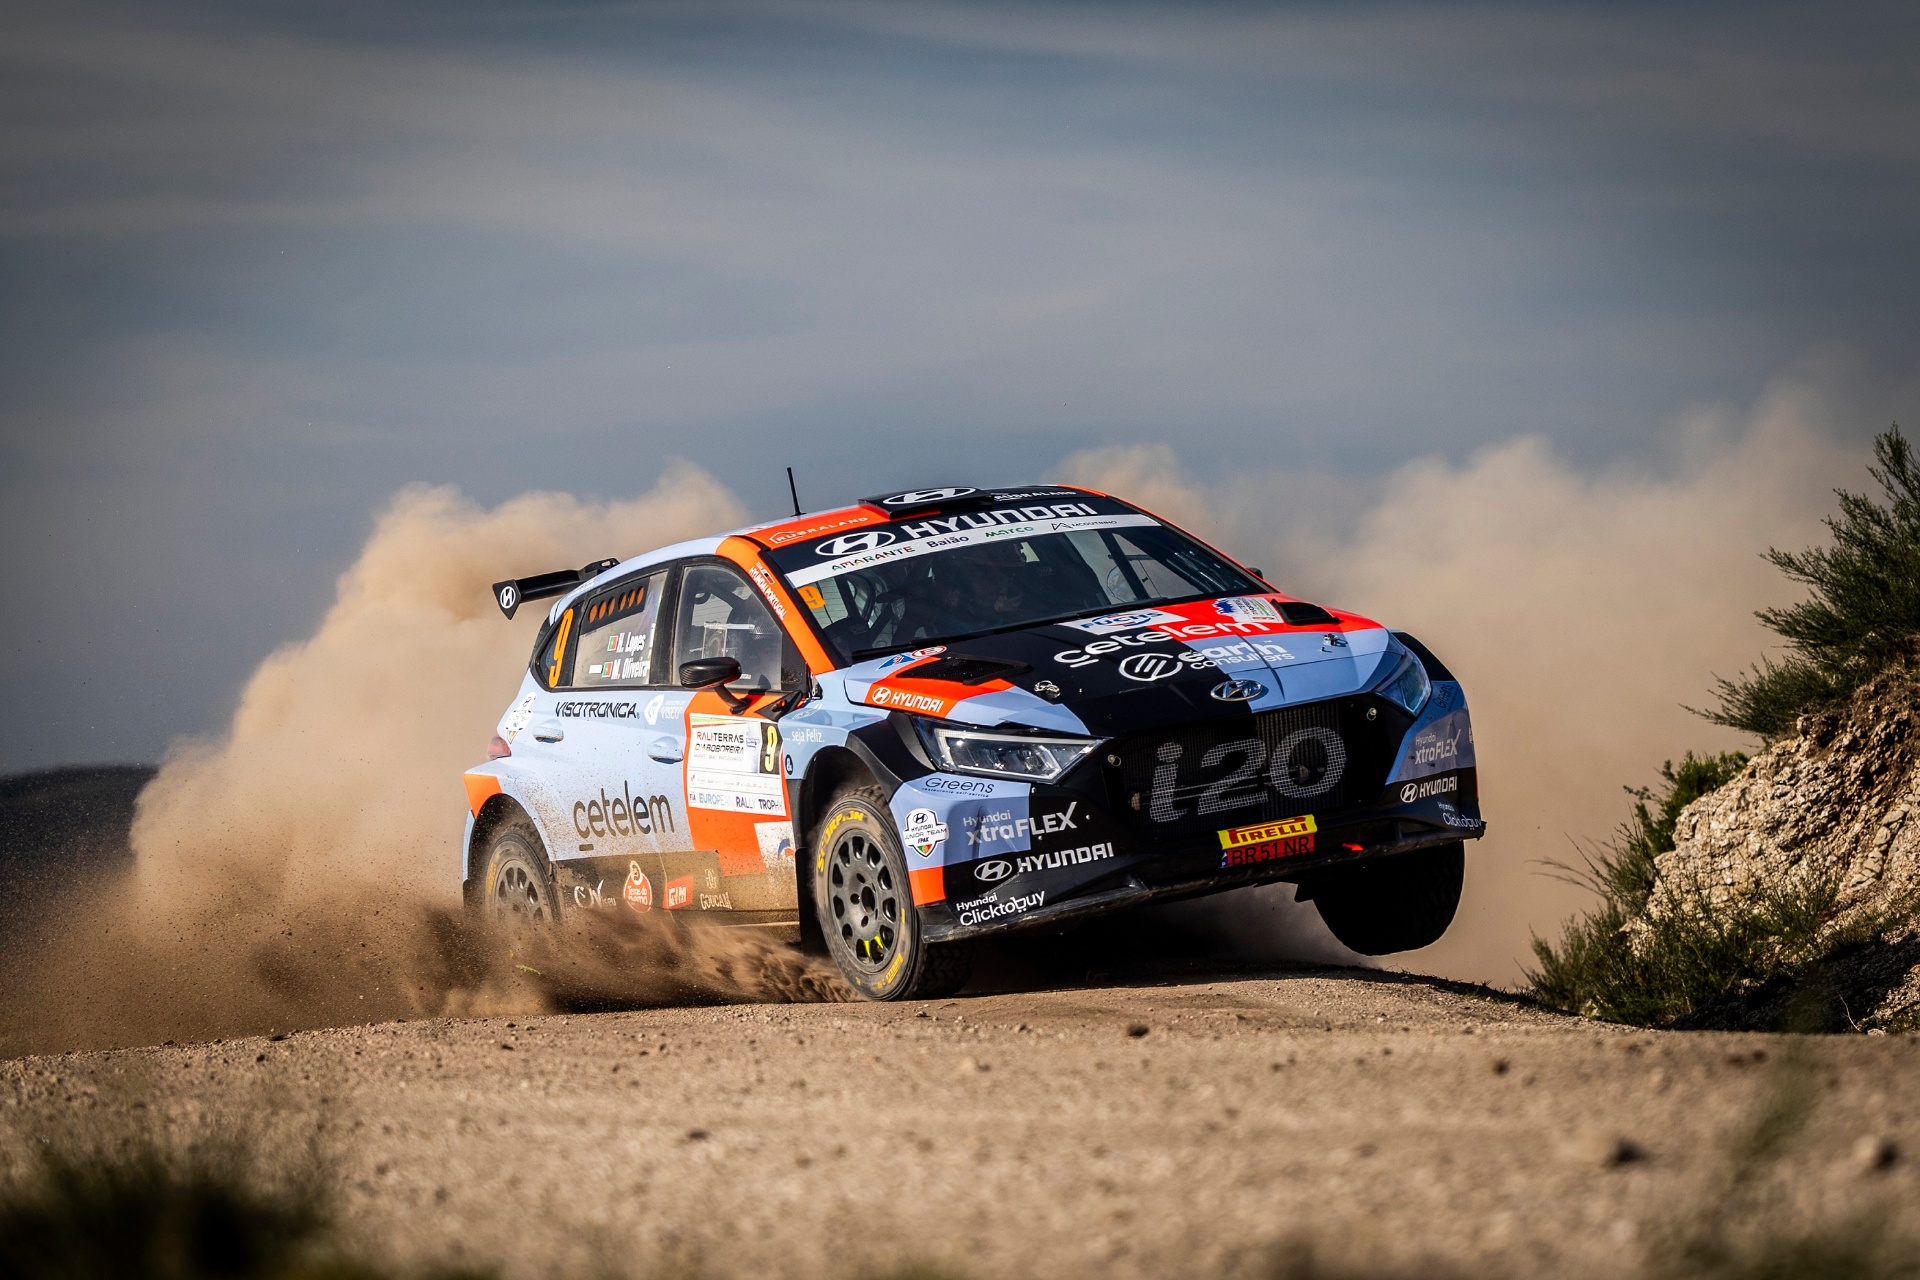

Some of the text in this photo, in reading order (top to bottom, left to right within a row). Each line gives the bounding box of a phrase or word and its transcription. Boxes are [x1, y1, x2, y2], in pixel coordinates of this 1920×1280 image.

[776, 516, 869, 542] RUBRALAND
[900, 503, 1098, 539] HYUNDAI
[831, 545, 916, 571] AMARANTE
[926, 535, 970, 549] Baião
[764, 586, 787, 621] PORTUGAL
[797, 585, 826, 609] 9
[1080, 611, 1164, 629] FUCHS
[548, 608, 574, 688] 9
[625, 632, 646, 656] Lopes
[1053, 621, 1270, 668] cetelem
[611, 657, 650, 680] M. Oliveira
[555, 702, 637, 718] VISOTRONICA
[890, 691, 944, 713] HYUNDAI
[765, 725, 778, 772] 9
[791, 728, 805, 745] seja
[1414, 729, 1462, 765] xtraFLEX
[1416, 732, 1437, 746] Hyundai
[925, 777, 995, 794] Greens
[1150, 726, 1347, 833] i20
[1420, 775, 1458, 798] HYUNDAI
[573, 780, 675, 852] cetelem
[910, 823, 933, 832] HYUNDAI
[963, 810, 1012, 827] Hyundai
[965, 802, 1078, 846] xtraFLEX
[1228, 816, 1308, 845] PIRELLI
[1016, 841, 1115, 873] HYUNDAI
[956, 892, 998, 912] Hyundai
[959, 890, 1046, 926] Clicktobuy
